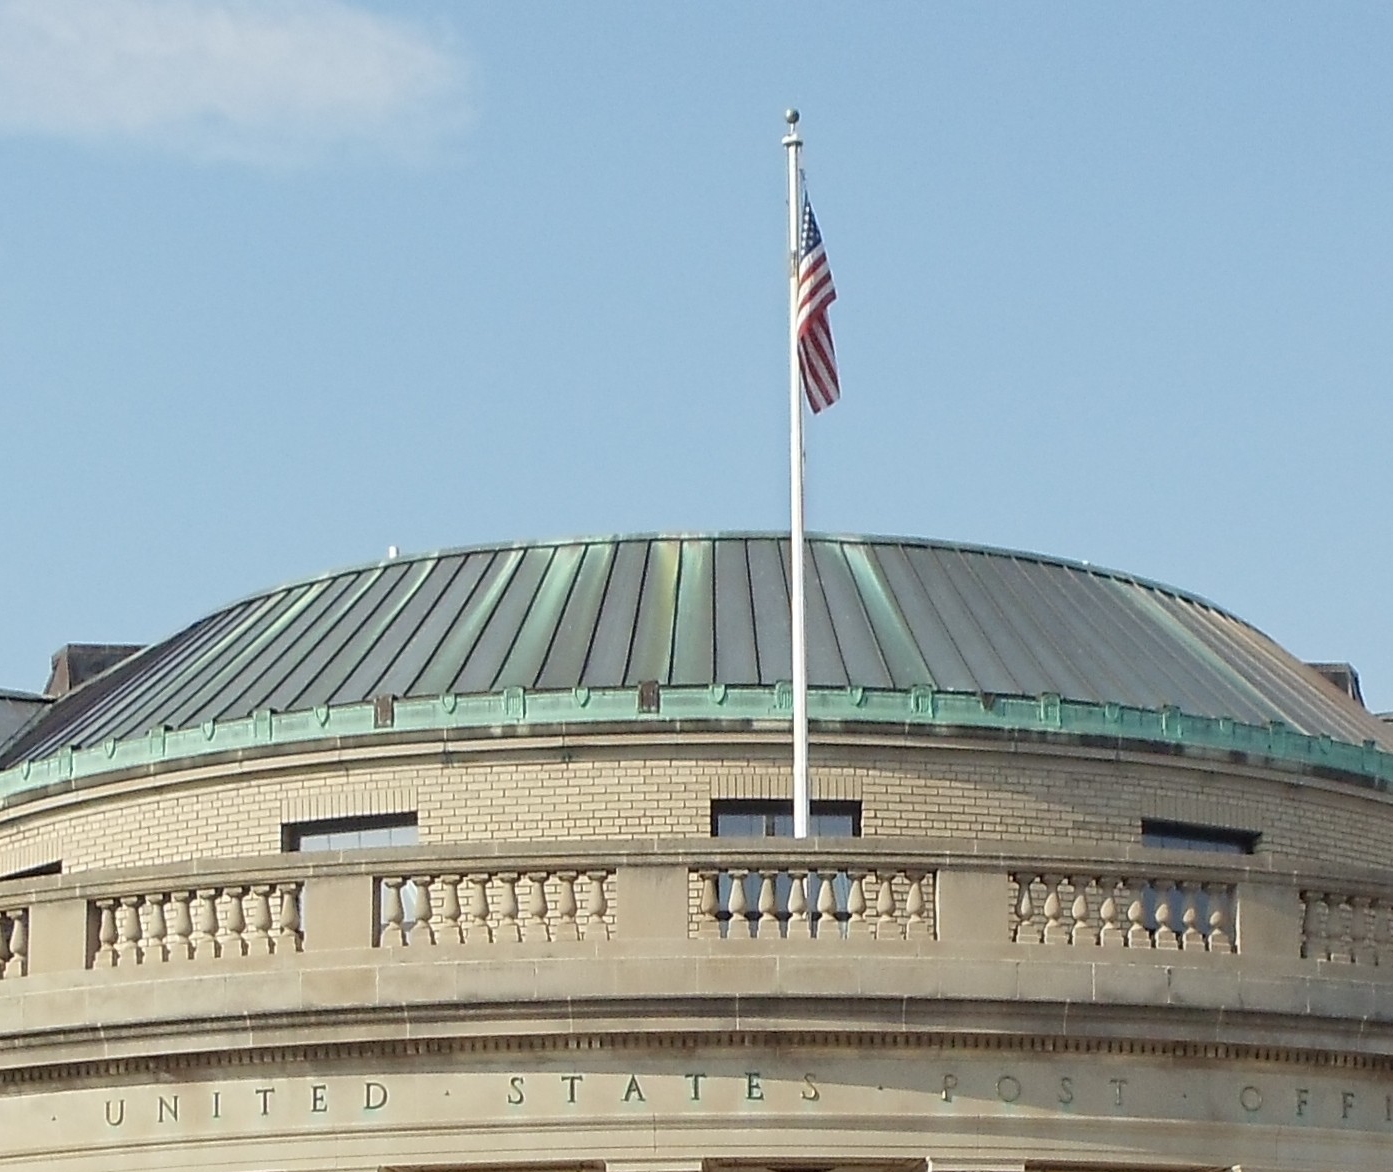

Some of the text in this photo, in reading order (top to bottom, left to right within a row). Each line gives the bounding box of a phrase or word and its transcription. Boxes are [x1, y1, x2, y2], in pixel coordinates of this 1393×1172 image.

[105, 1082, 389, 1126] UNITED
[507, 1072, 820, 1105] STATES
[940, 1073, 1128, 1106] POST
